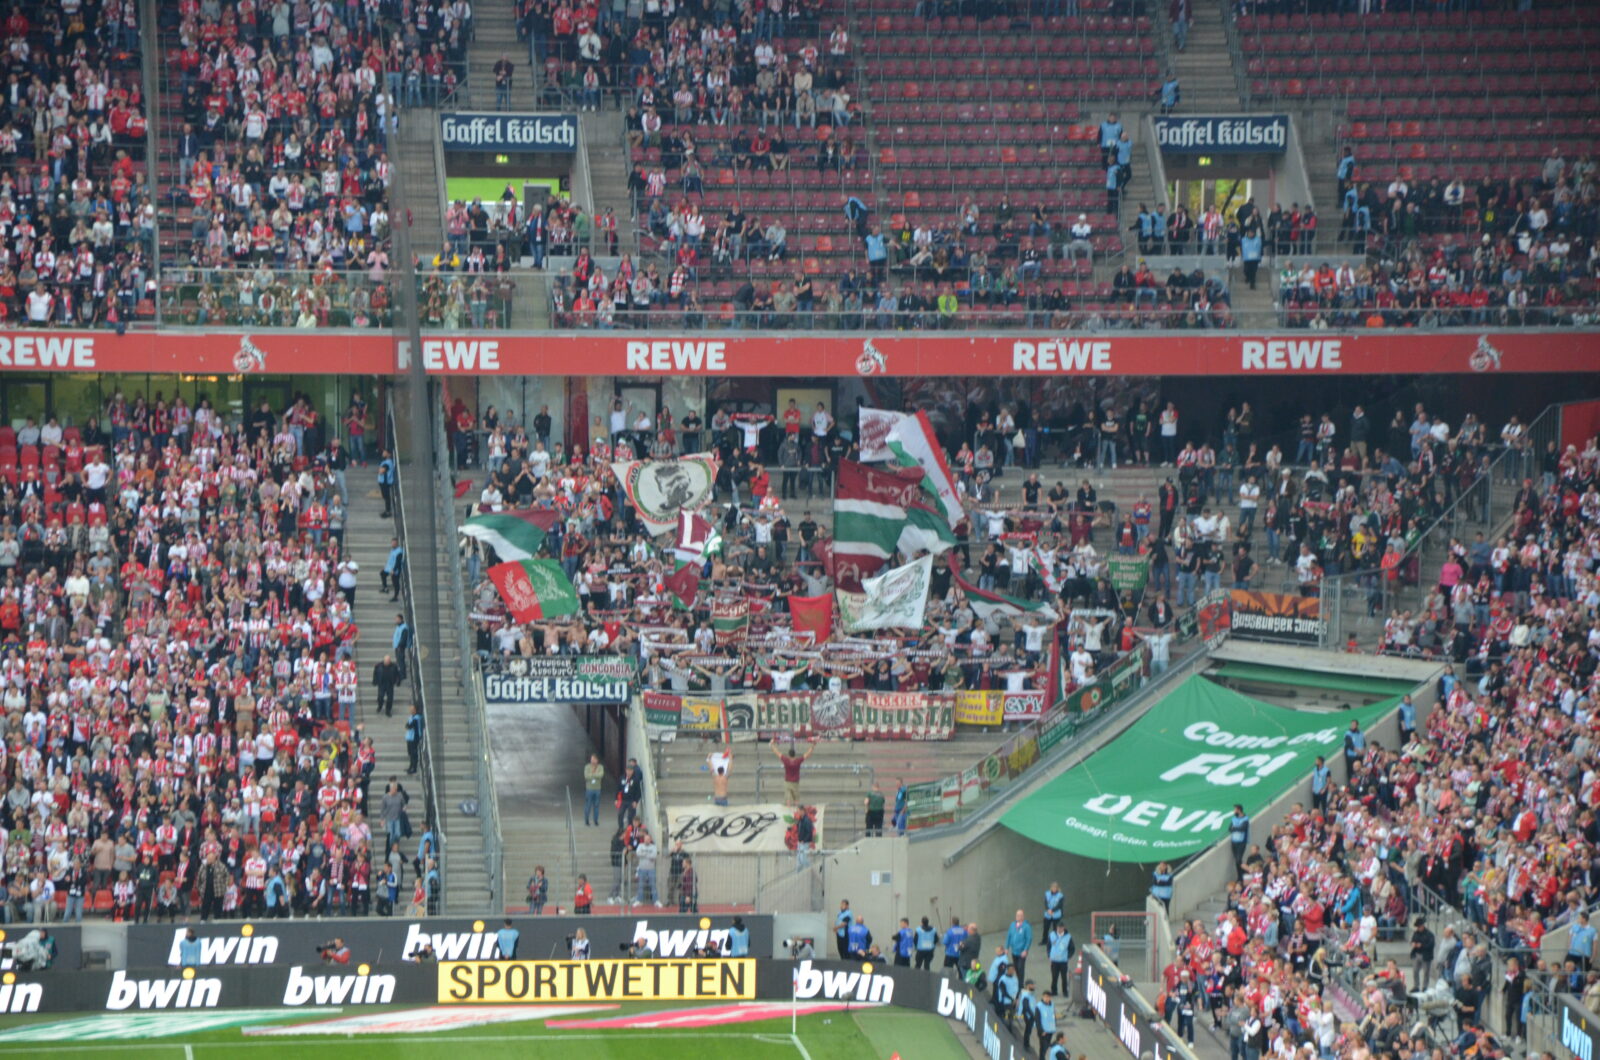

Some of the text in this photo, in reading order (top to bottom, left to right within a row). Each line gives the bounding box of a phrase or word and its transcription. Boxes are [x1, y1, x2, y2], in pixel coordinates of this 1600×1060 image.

[442, 118, 575, 147] Gaffel Kölsch
[1156, 118, 1285, 146] Gaffel Kölsch
[0, 337, 96, 368] REWE
[626, 341, 726, 370] REWE
[1012, 341, 1111, 370] REWE
[1242, 340, 1342, 369] REWE
[579, 663, 631, 674] CONCORDIA
[757, 702, 810, 726] LEGIO
[853, 704, 953, 728] AUGUSTA
[1183, 721, 1288, 749] Come
[1159, 751, 1298, 787] FC!
[1082, 793, 1236, 833] DEVK
[106, 968, 222, 1012] bwin
[283, 964, 396, 1006] bwin
[450, 963, 745, 999] SPORTWETTEN
[795, 961, 895, 1004] bwin
[1087, 965, 1107, 1020] bwin
[937, 977, 976, 1033] bwin
[1120, 1002, 1140, 1060] bwin
[1562, 1005, 1593, 1060] bwin
